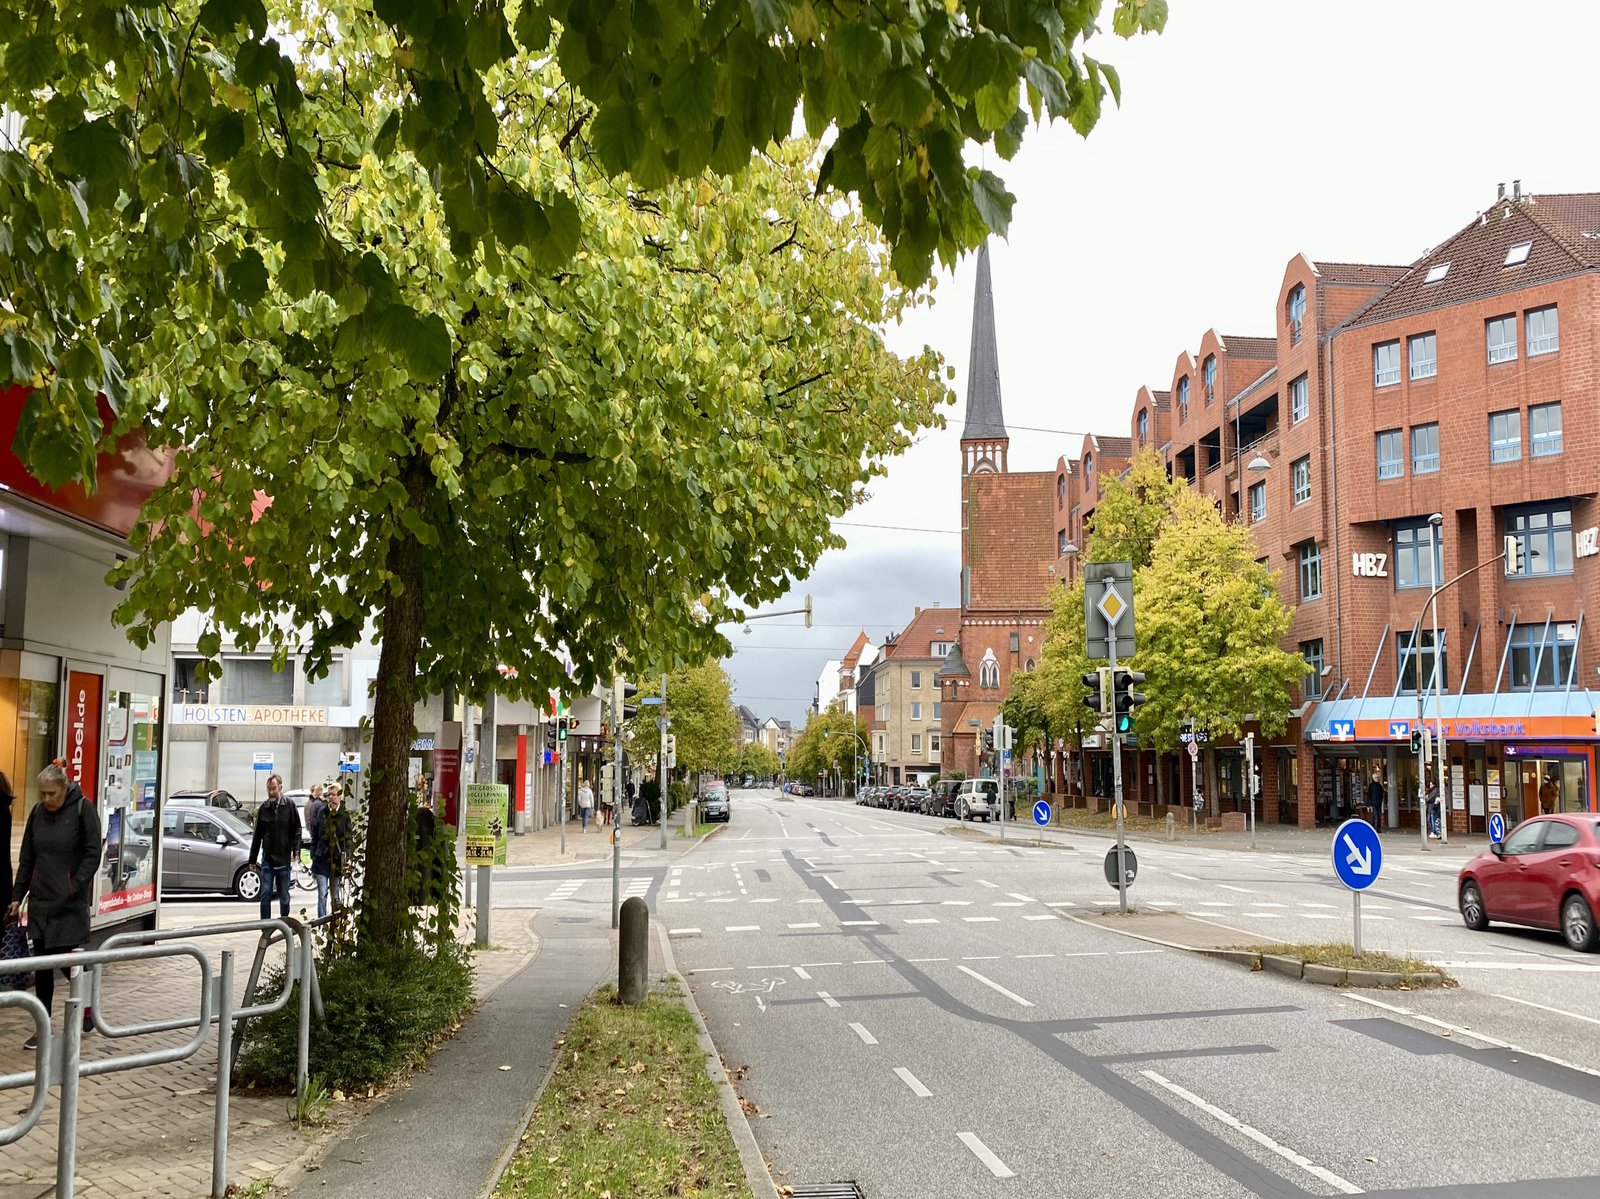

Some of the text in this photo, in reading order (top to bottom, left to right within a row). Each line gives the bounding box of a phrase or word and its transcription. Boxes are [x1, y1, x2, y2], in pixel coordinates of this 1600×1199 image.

[1575, 527, 1600, 559] HBZ
[1352, 552, 1388, 577] HBZ
[184, 707, 325, 723] HOLSTEN APOTHEKE
[72, 689, 86, 782] ubel.de
[1454, 720, 1525, 736] Volksbank
